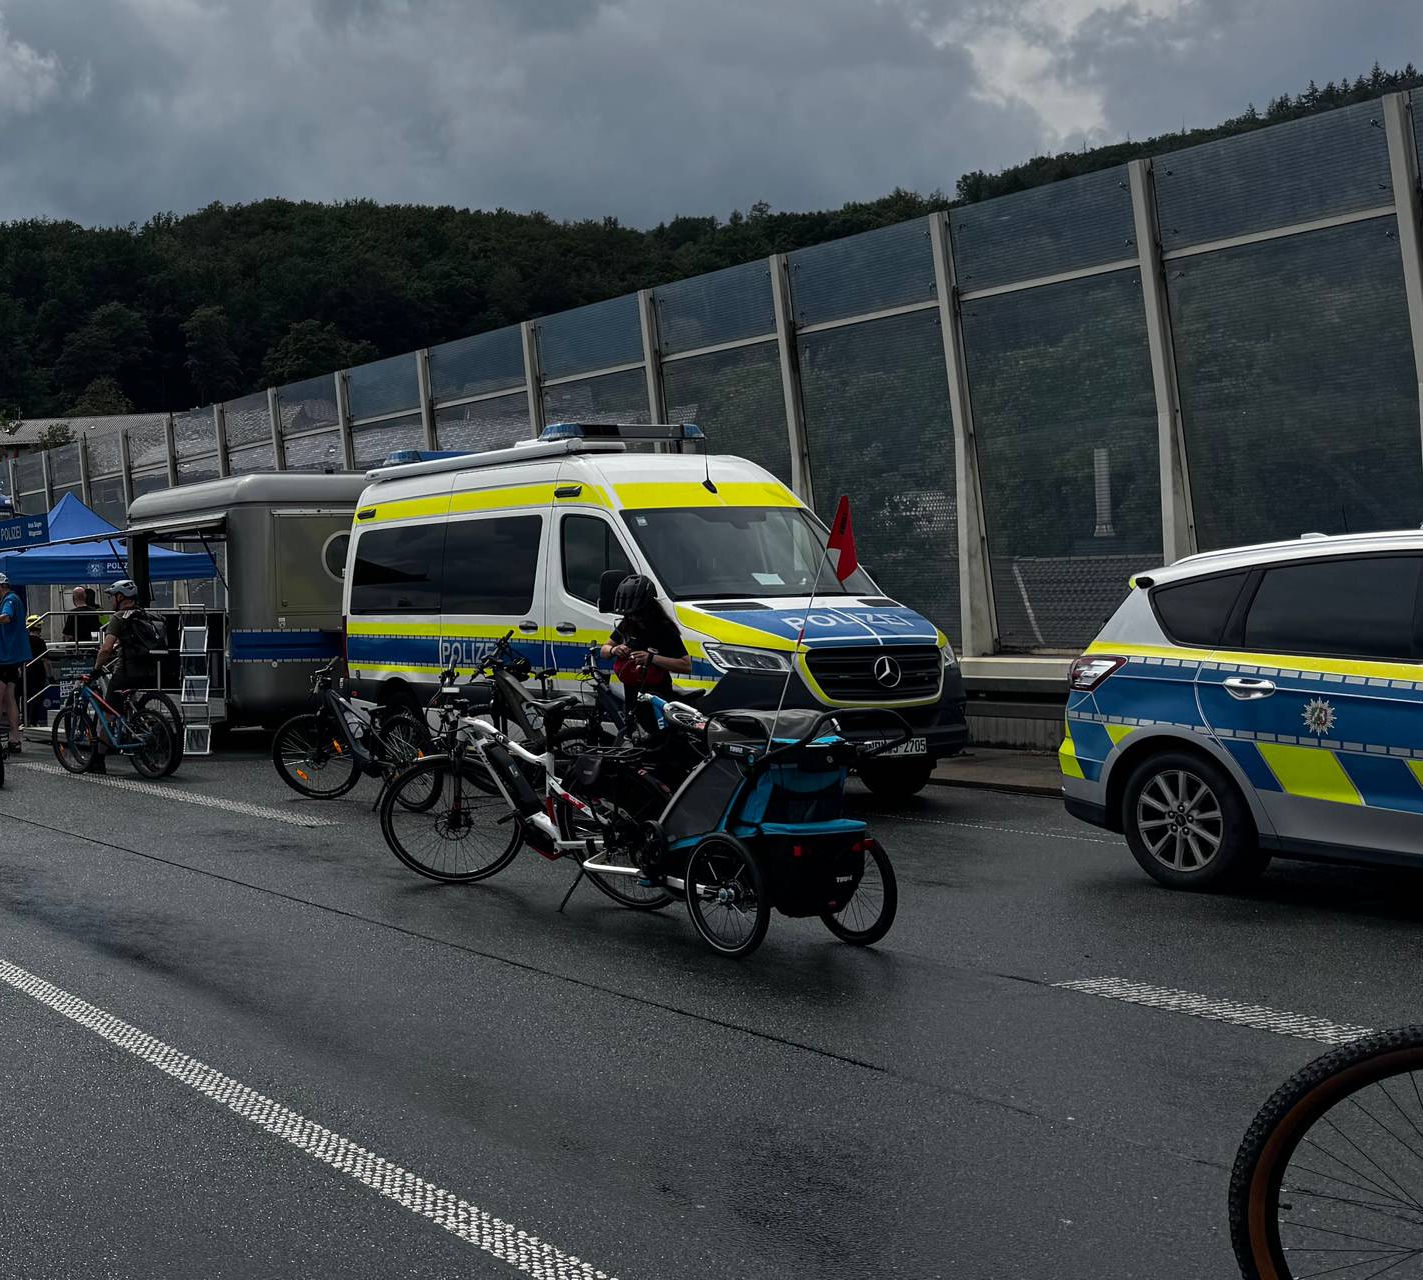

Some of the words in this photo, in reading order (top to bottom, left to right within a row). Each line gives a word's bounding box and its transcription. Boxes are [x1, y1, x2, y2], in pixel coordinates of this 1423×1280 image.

[0, 525, 22, 541] POLIZEI
[106, 562, 128, 570] POLZ
[781, 612, 915, 631] POLIZEI
[442, 642, 497, 663] POLIZE
